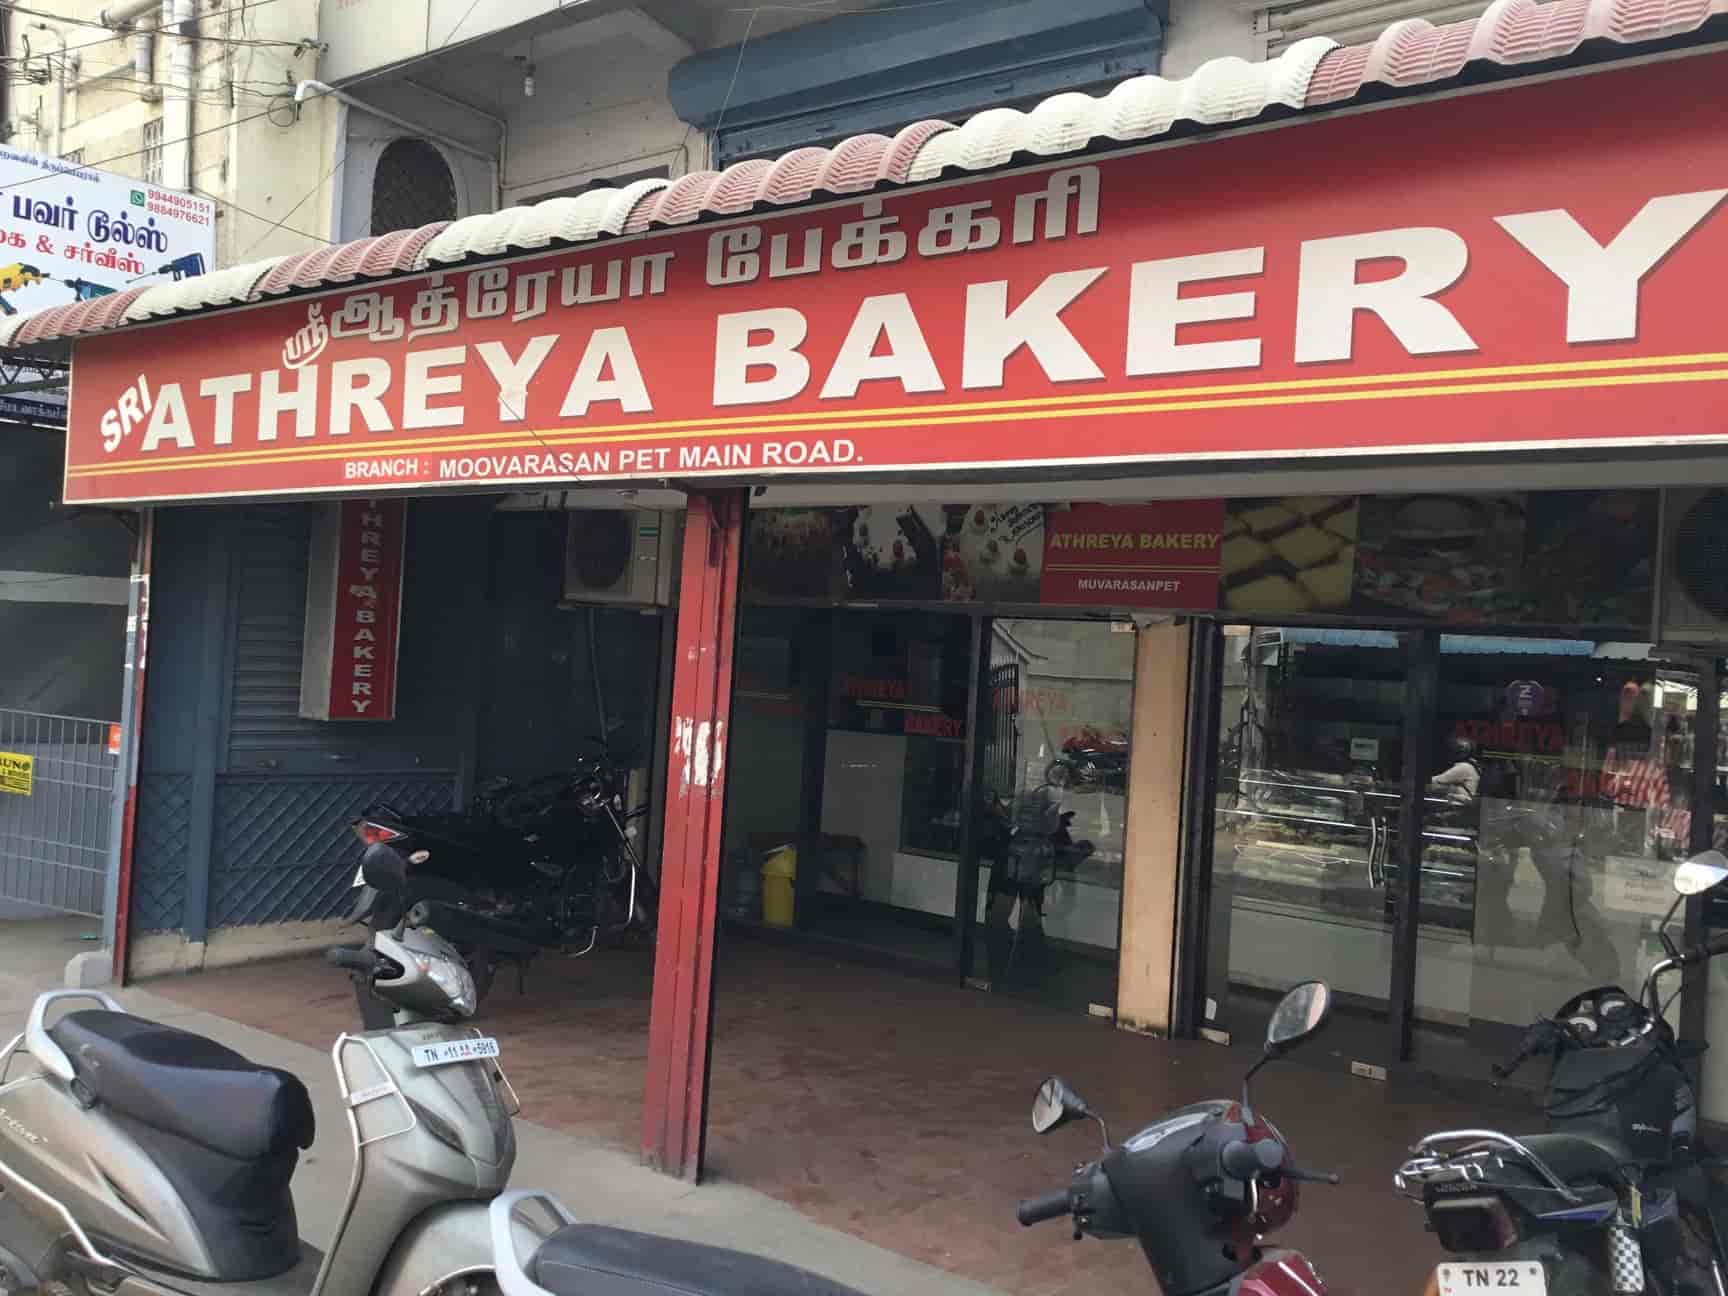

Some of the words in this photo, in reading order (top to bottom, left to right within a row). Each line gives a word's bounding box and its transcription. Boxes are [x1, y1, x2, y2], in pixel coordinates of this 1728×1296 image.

[13, 195, 78, 231] பவர்
[87, 209, 167, 253] டூல்ஸ்
[705, 165, 1101, 287] பேக்கரி
[63, 242, 145, 274] சர்வீஸ்
[100, 373, 152, 454] SRI
[141, 326, 654, 452] ATHREYA
[712, 188, 1728, 407] BAKERY
[439, 452, 610, 479] MOOVARASAN
[618, 447, 672, 471] PET
[679, 442, 758, 468] MAIN
[1050, 533, 1135, 550] ATHREYA
[1139, 532, 1221, 550] BAKERY
[1077, 578, 1182, 593] MUVARASANPET
[351, 609, 377, 713] BAKERY
[424, 1048, 439, 1063] TN
[1462, 1269, 1490, 1287] TN
[1496, 1269, 1521, 1287] 22
